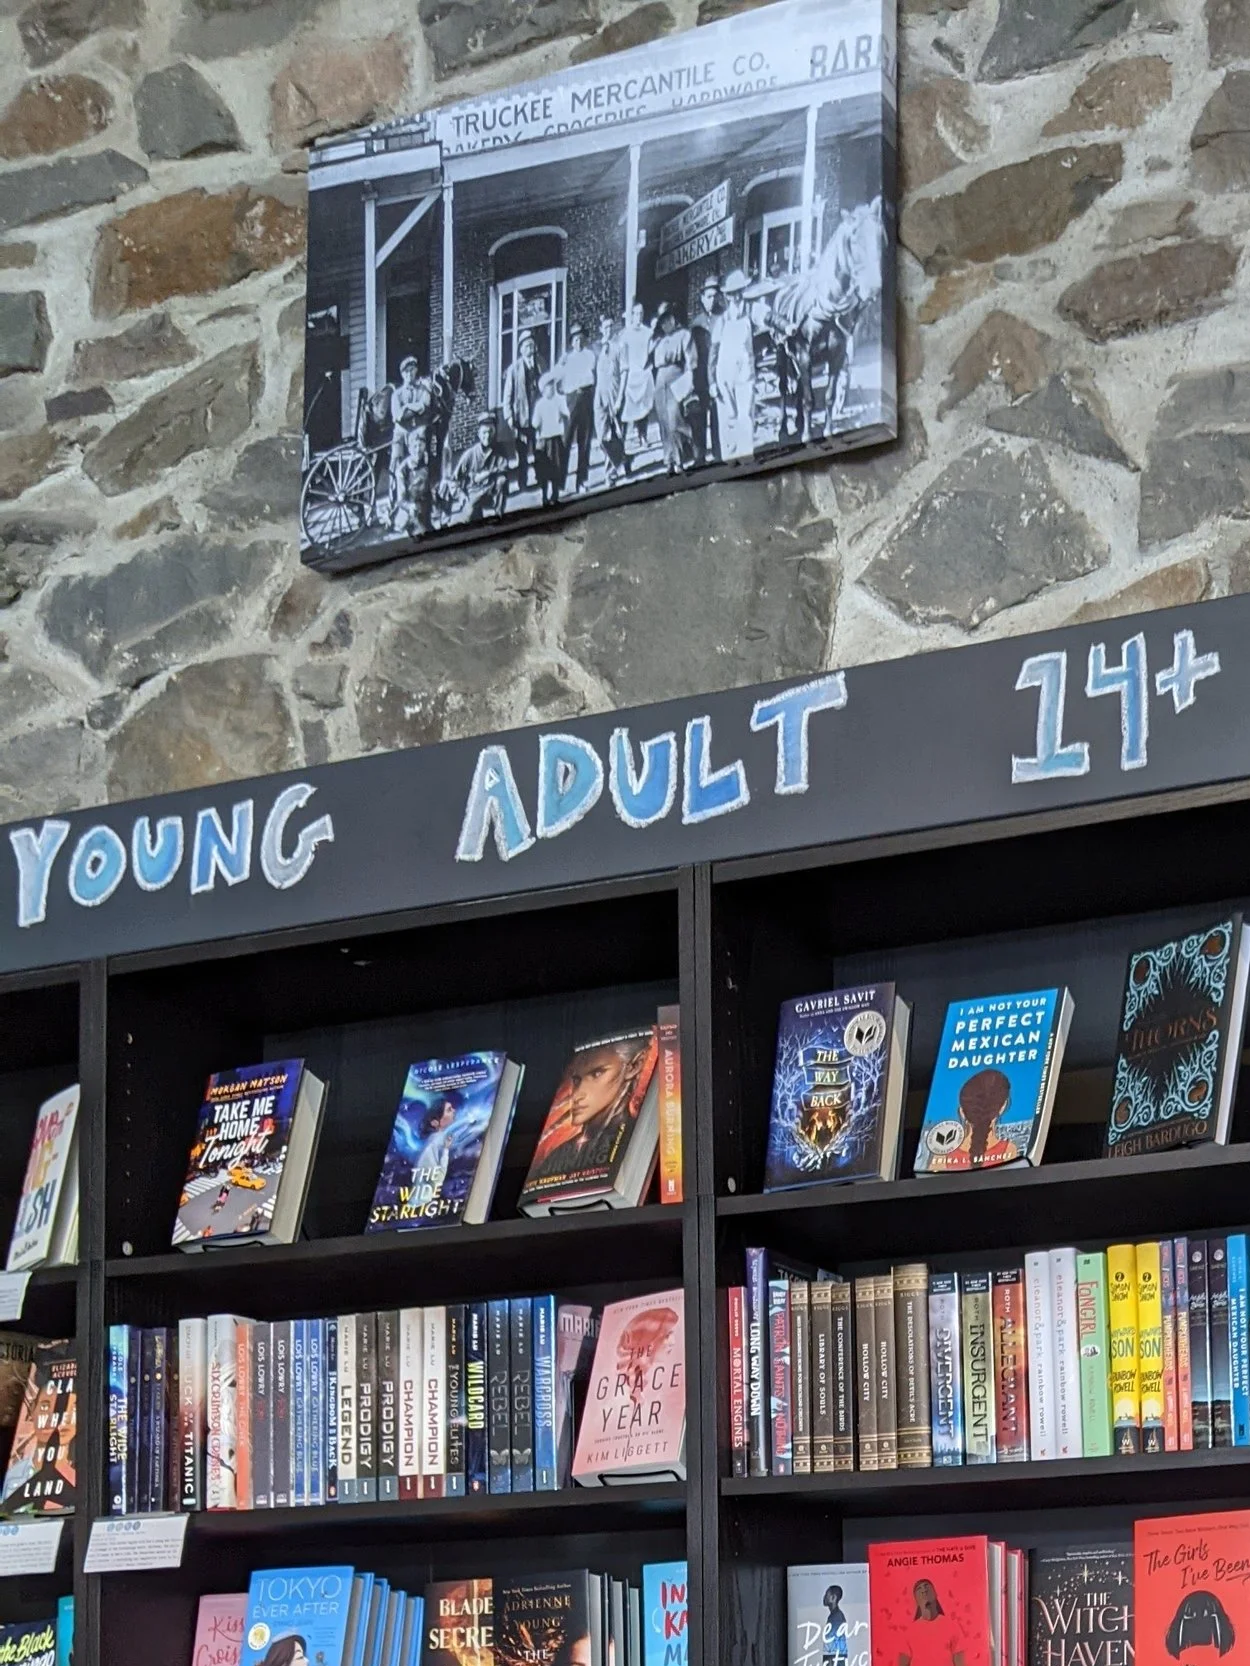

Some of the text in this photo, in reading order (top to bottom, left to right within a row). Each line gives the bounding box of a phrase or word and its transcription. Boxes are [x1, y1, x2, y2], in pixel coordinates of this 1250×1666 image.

[452, 98, 553, 137] TRUCKEE
[571, 63, 716, 113] MERCANTILE
[733, 51, 770, 76] CO.
[9, 629, 1221, 928] YOUNG ADULT 14+
[795, 997, 840, 1013] GAVRIEL
[844, 990, 876, 1005] SAVIT
[960, 998, 1047, 1016] I AM NOT YOUR
[955, 1011, 1045, 1034] PERFECT
[951, 1031, 1040, 1052] MEXICAN
[816, 1050, 839, 1062] THE
[948, 1050, 1038, 1069] DAUGHTER
[664, 1049, 674, 1098] AURORA
[814, 1071, 839, 1083] WAY
[214, 1100, 250, 1122] TAKE
[251, 1095, 275, 1116] ME
[810, 1093, 841, 1107] BACK
[218, 1116, 259, 1140] HOME
[199, 1129, 273, 1170] Tonight
[411, 1167, 441, 1184] THE
[399, 1184, 442, 1203] WIDE
[370, 1199, 464, 1224] STARLIGHT
[1112, 1337, 1135, 1358] SON
[596, 1363, 682, 1400] GRACE
[970, 1323, 988, 1442] INSURGENT
[732, 1348, 742, 1448] MORTAL ENGINES
[340, 1385, 353, 1466] LEGEND
[360, 1381, 372, 1469] PRODIGY
[403, 1379, 414, 1466] CHAMPION
[601, 1401, 662, 1432] YEAR
[37, 1446, 64, 1462] YOU
[23, 1480, 64, 1498] LAND
[887, 1554, 965, 1567] ANGIE THOMAS
[1143, 1539, 1210, 1576] The Girls
[259, 1574, 342, 1603] TOKYO
[1084, 1592, 1112, 1606] THE
[253, 1601, 340, 1619] EVER AFTER
[439, 1597, 494, 1617] BLADE
[504, 1595, 571, 1612] ADRIENNE
[797, 1620, 867, 1651] Dear
